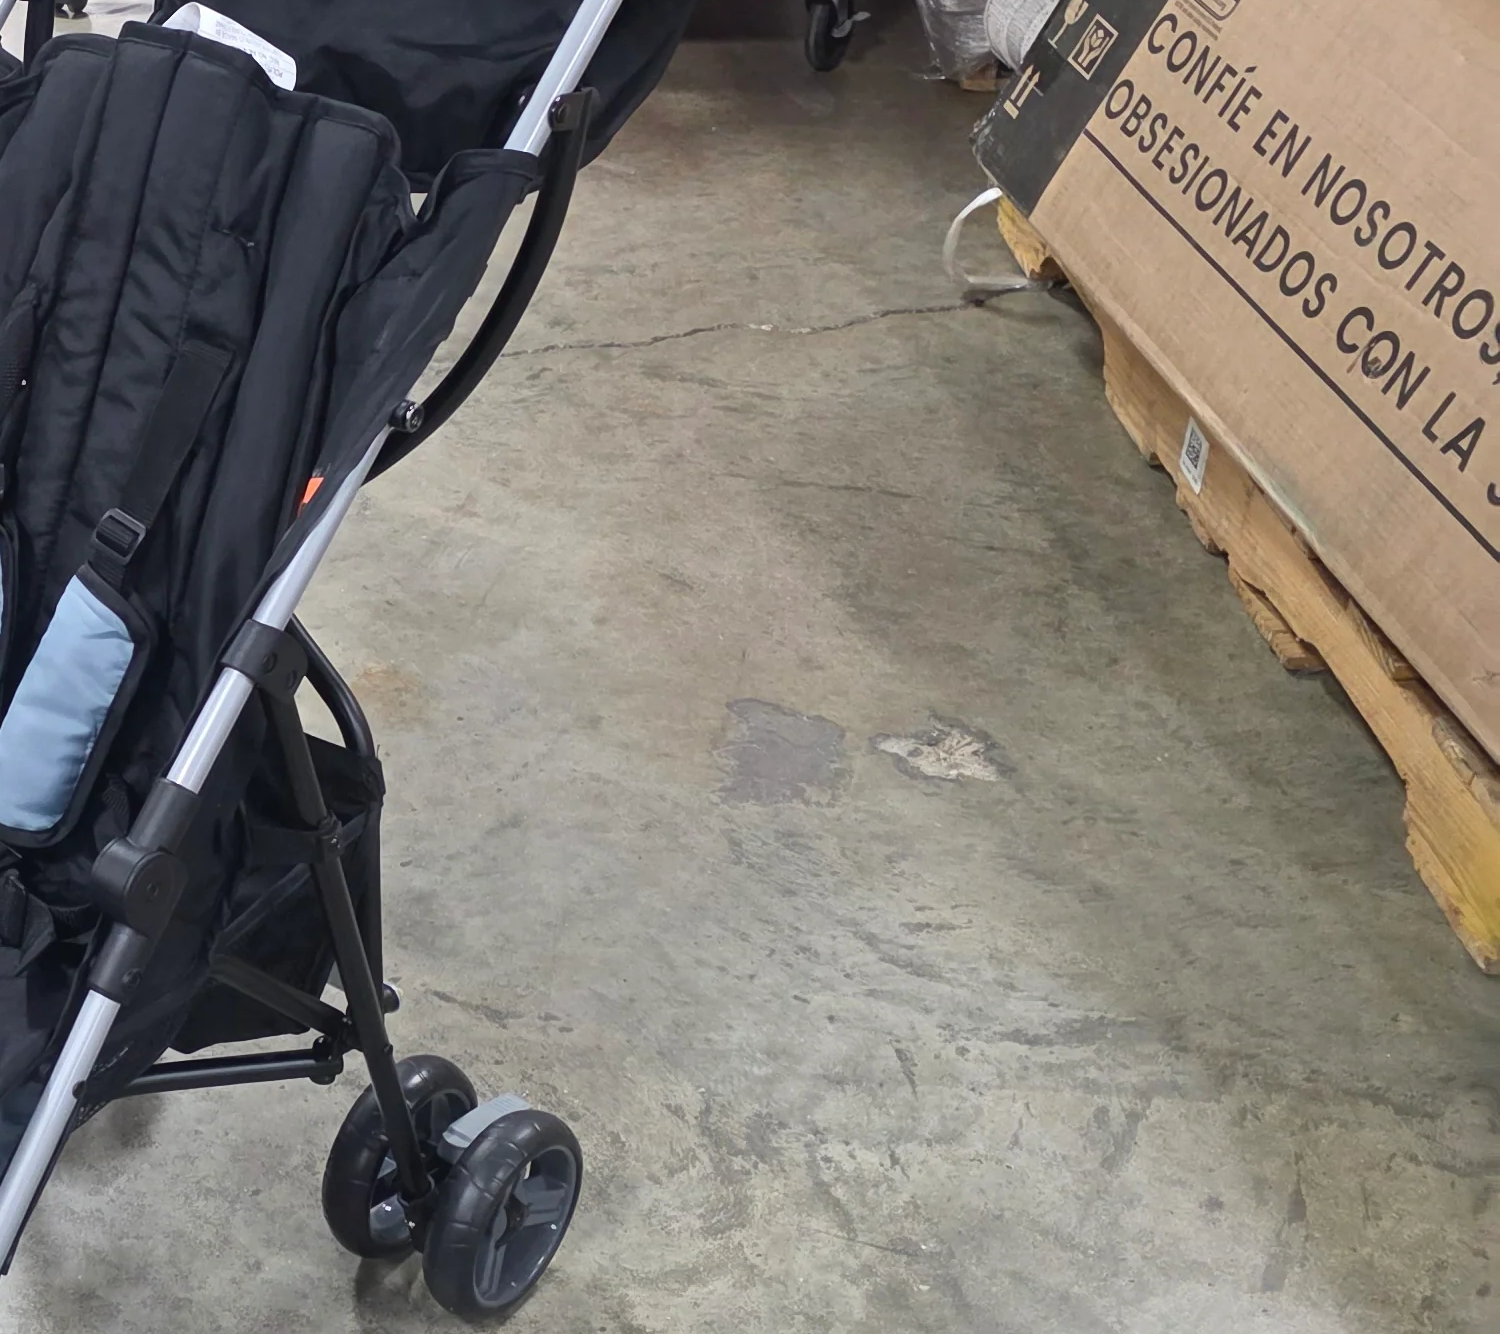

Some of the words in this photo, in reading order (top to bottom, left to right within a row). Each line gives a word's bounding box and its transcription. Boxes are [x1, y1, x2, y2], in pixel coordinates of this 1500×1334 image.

[1147, 13, 1262, 132] CONFÍE
[1253, 109, 1312, 177] EN
[1105, 79, 1338, 319] OBSESIONADOS
[1336, 306, 1431, 410] CON
[1422, 392, 1486, 472] LA
